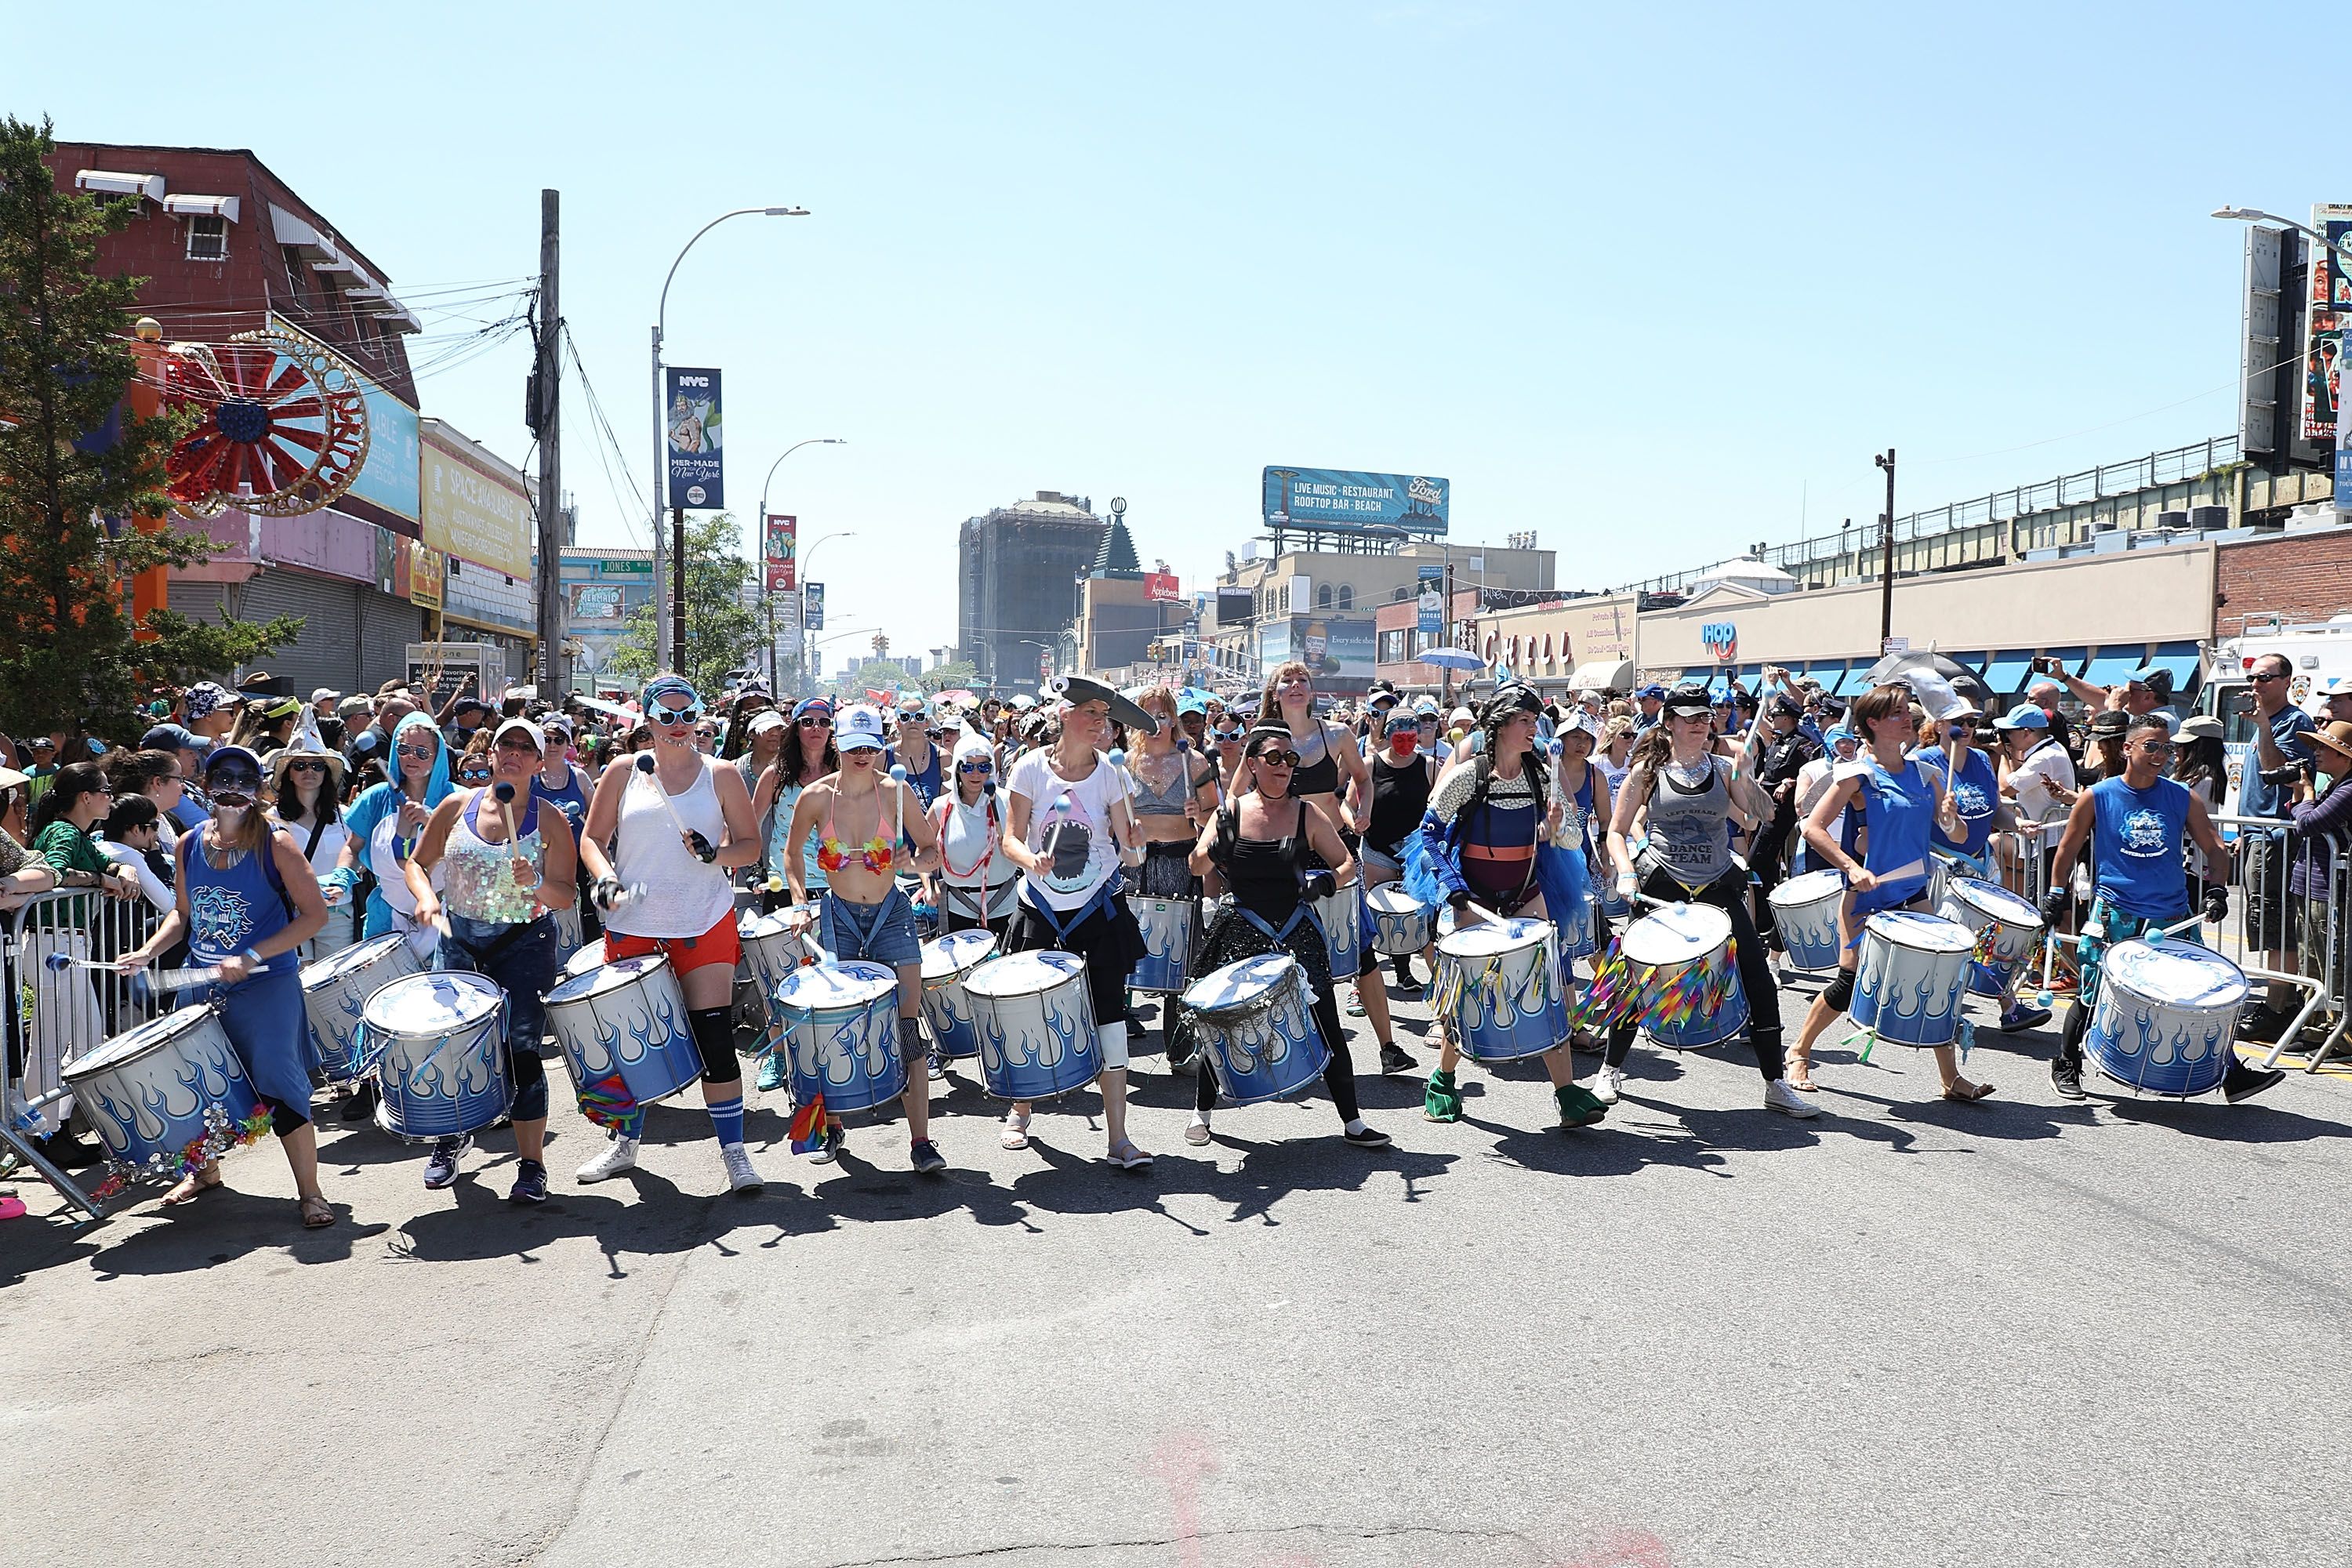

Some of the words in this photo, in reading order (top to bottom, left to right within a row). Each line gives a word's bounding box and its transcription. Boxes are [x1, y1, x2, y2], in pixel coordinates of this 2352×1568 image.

[680, 376, 709, 387] NYC
[671, 459, 720, 467] MER-MADE
[671, 466, 695, 479] New
[695, 466, 720, 482] York
[1294, 482, 1312, 494] LIVE
[1313, 484, 1337, 495] MUSIC
[1342, 485, 1394, 499] RESTAURANT
[1409, 477, 1442, 500] Ford
[450, 467, 477, 505] SPACE
[479, 484, 514, 523] AVAILABLE
[1294, 496, 1330, 509] ROOFTOP
[1333, 499, 1349, 510] BAR
[1355, 499, 1381, 512] BEACH
[604, 561, 631, 572] JONES
[580, 593, 617, 604] MERMAID
[1331, 636, 1349, 646] Every
[1483, 630, 1574, 666] CHILL
[1578, 675, 1602, 687] CHILL
[1668, 844, 1713, 853] DANCE
[1668, 854, 1711, 864] TEAM
[218, 931, 234, 949] AZUL
[201, 942, 216, 953] NYC
